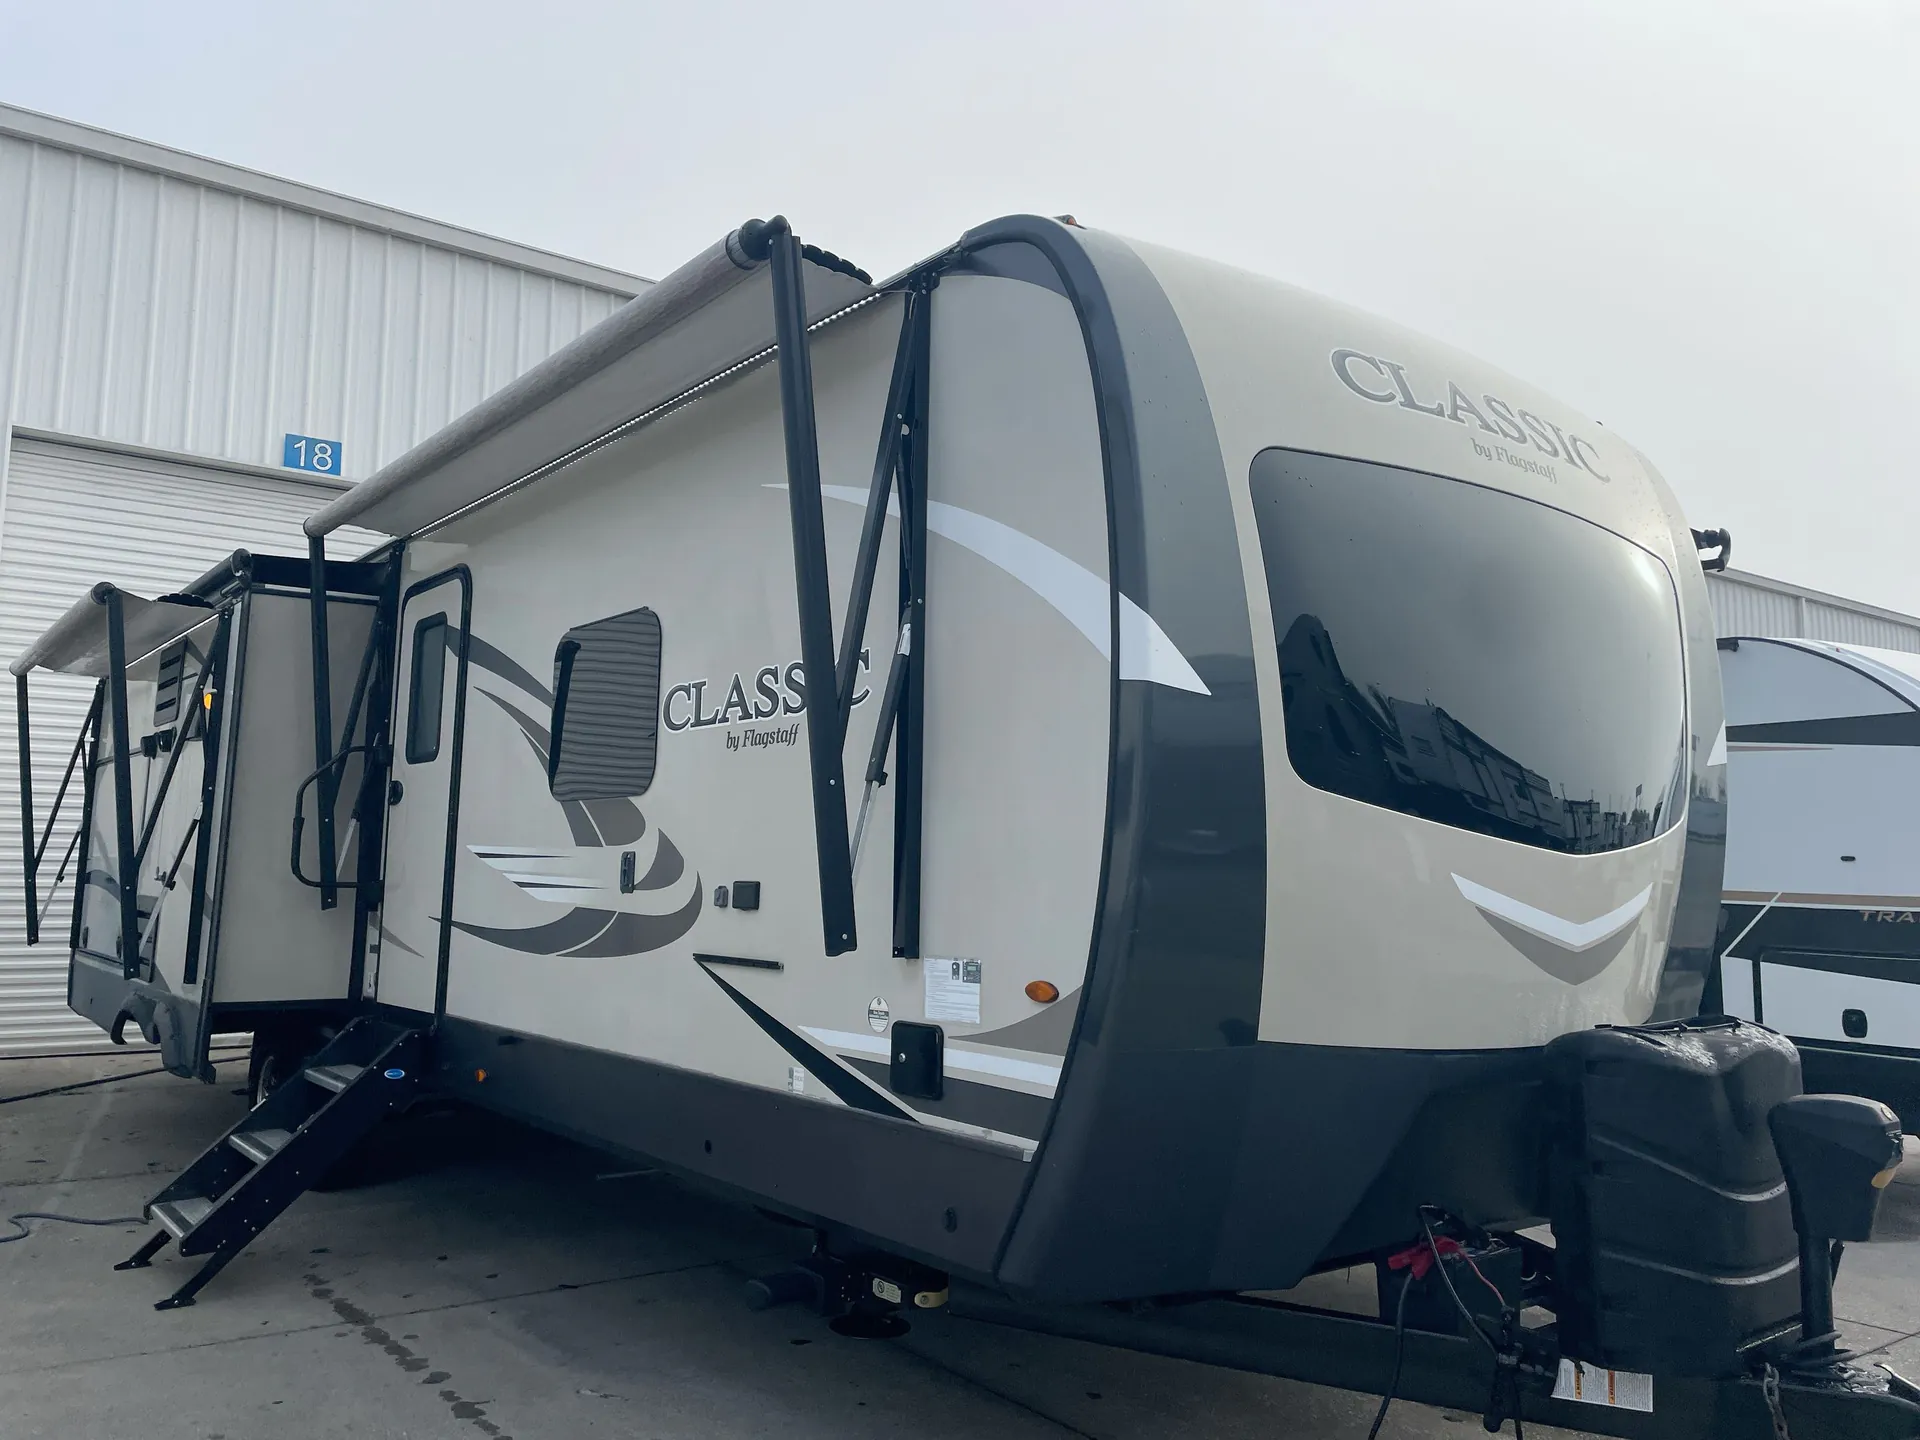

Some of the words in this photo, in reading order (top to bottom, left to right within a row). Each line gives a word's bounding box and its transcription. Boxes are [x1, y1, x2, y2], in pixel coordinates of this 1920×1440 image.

[1330, 348, 1611, 484] CLASSIC
[294, 440, 333, 471] 18
[1470, 437, 1493, 461] by
[1493, 445, 1558, 484] Flagstaff
[662, 648, 871, 732] CLASSC
[726, 731, 740, 751] by
[742, 723, 800, 748] Flagstaff
[1859, 910, 1920, 923] TRA
